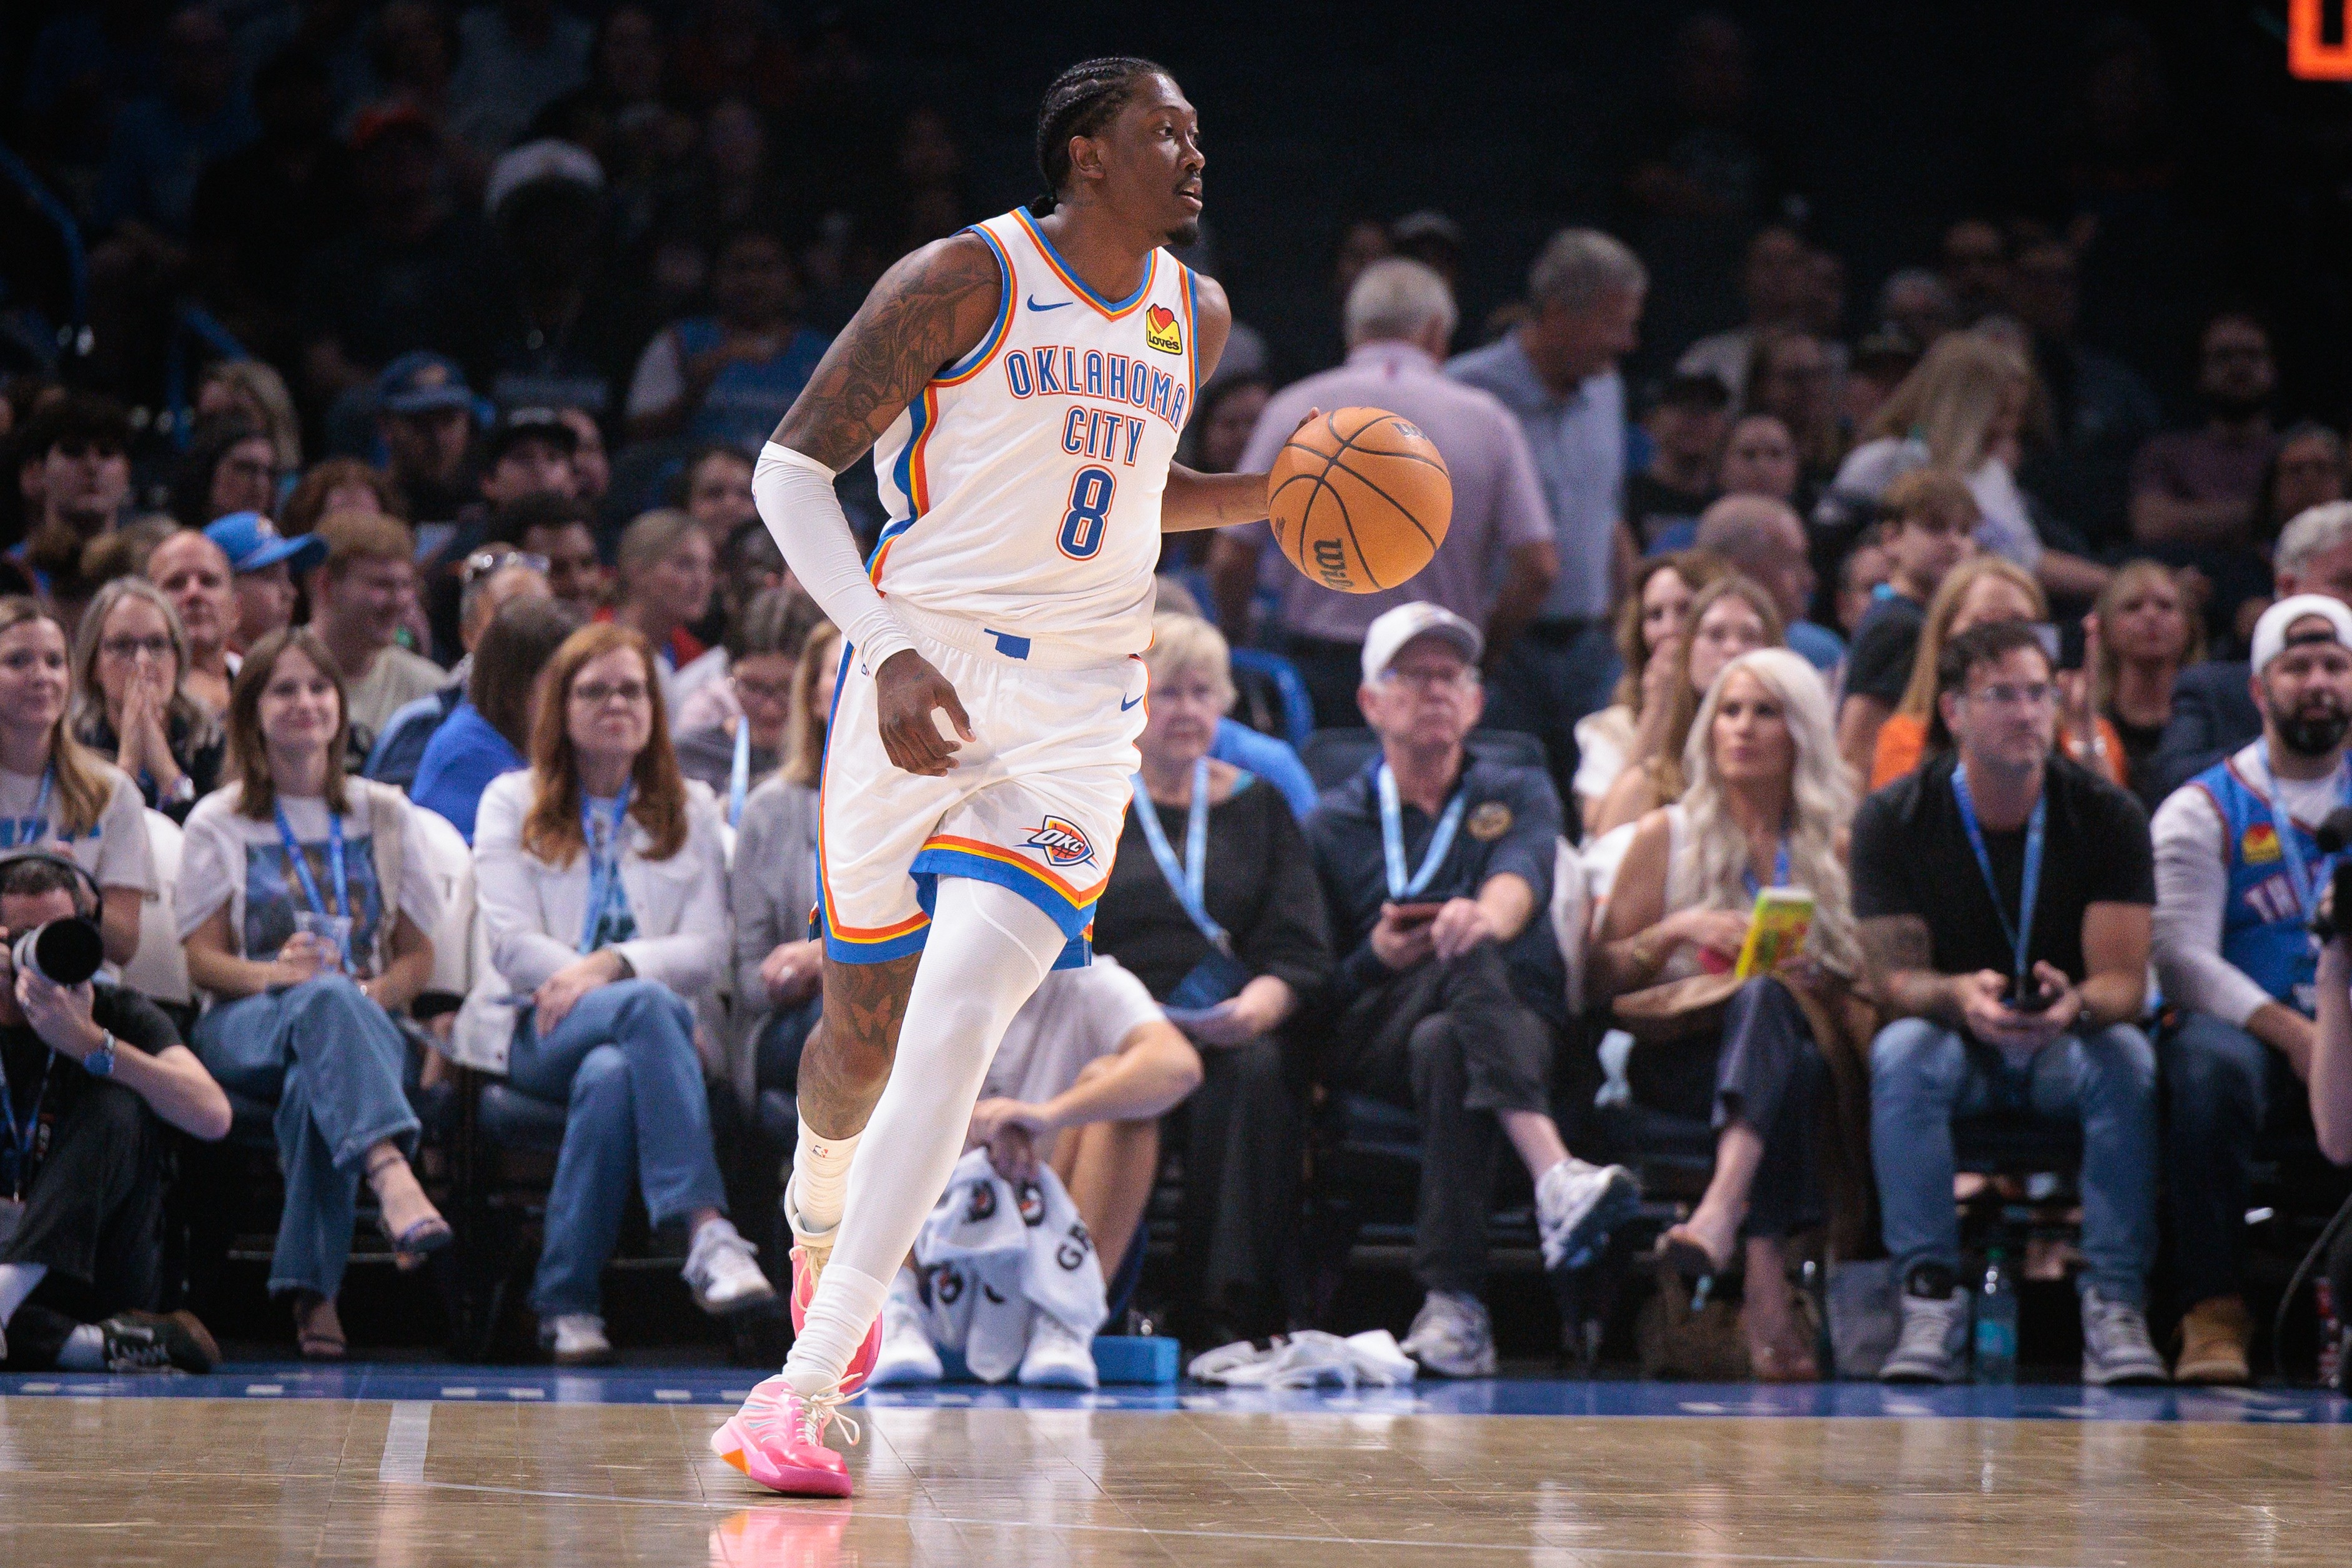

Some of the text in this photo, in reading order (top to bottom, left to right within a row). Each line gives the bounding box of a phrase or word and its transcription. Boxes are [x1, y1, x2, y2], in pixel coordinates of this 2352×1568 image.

[1004, 345, 1187, 433] OKLAHOMA
[1062, 405, 1146, 467] CITY
[1055, 463, 1117, 561] 8
[1027, 829, 1085, 852] OKC
